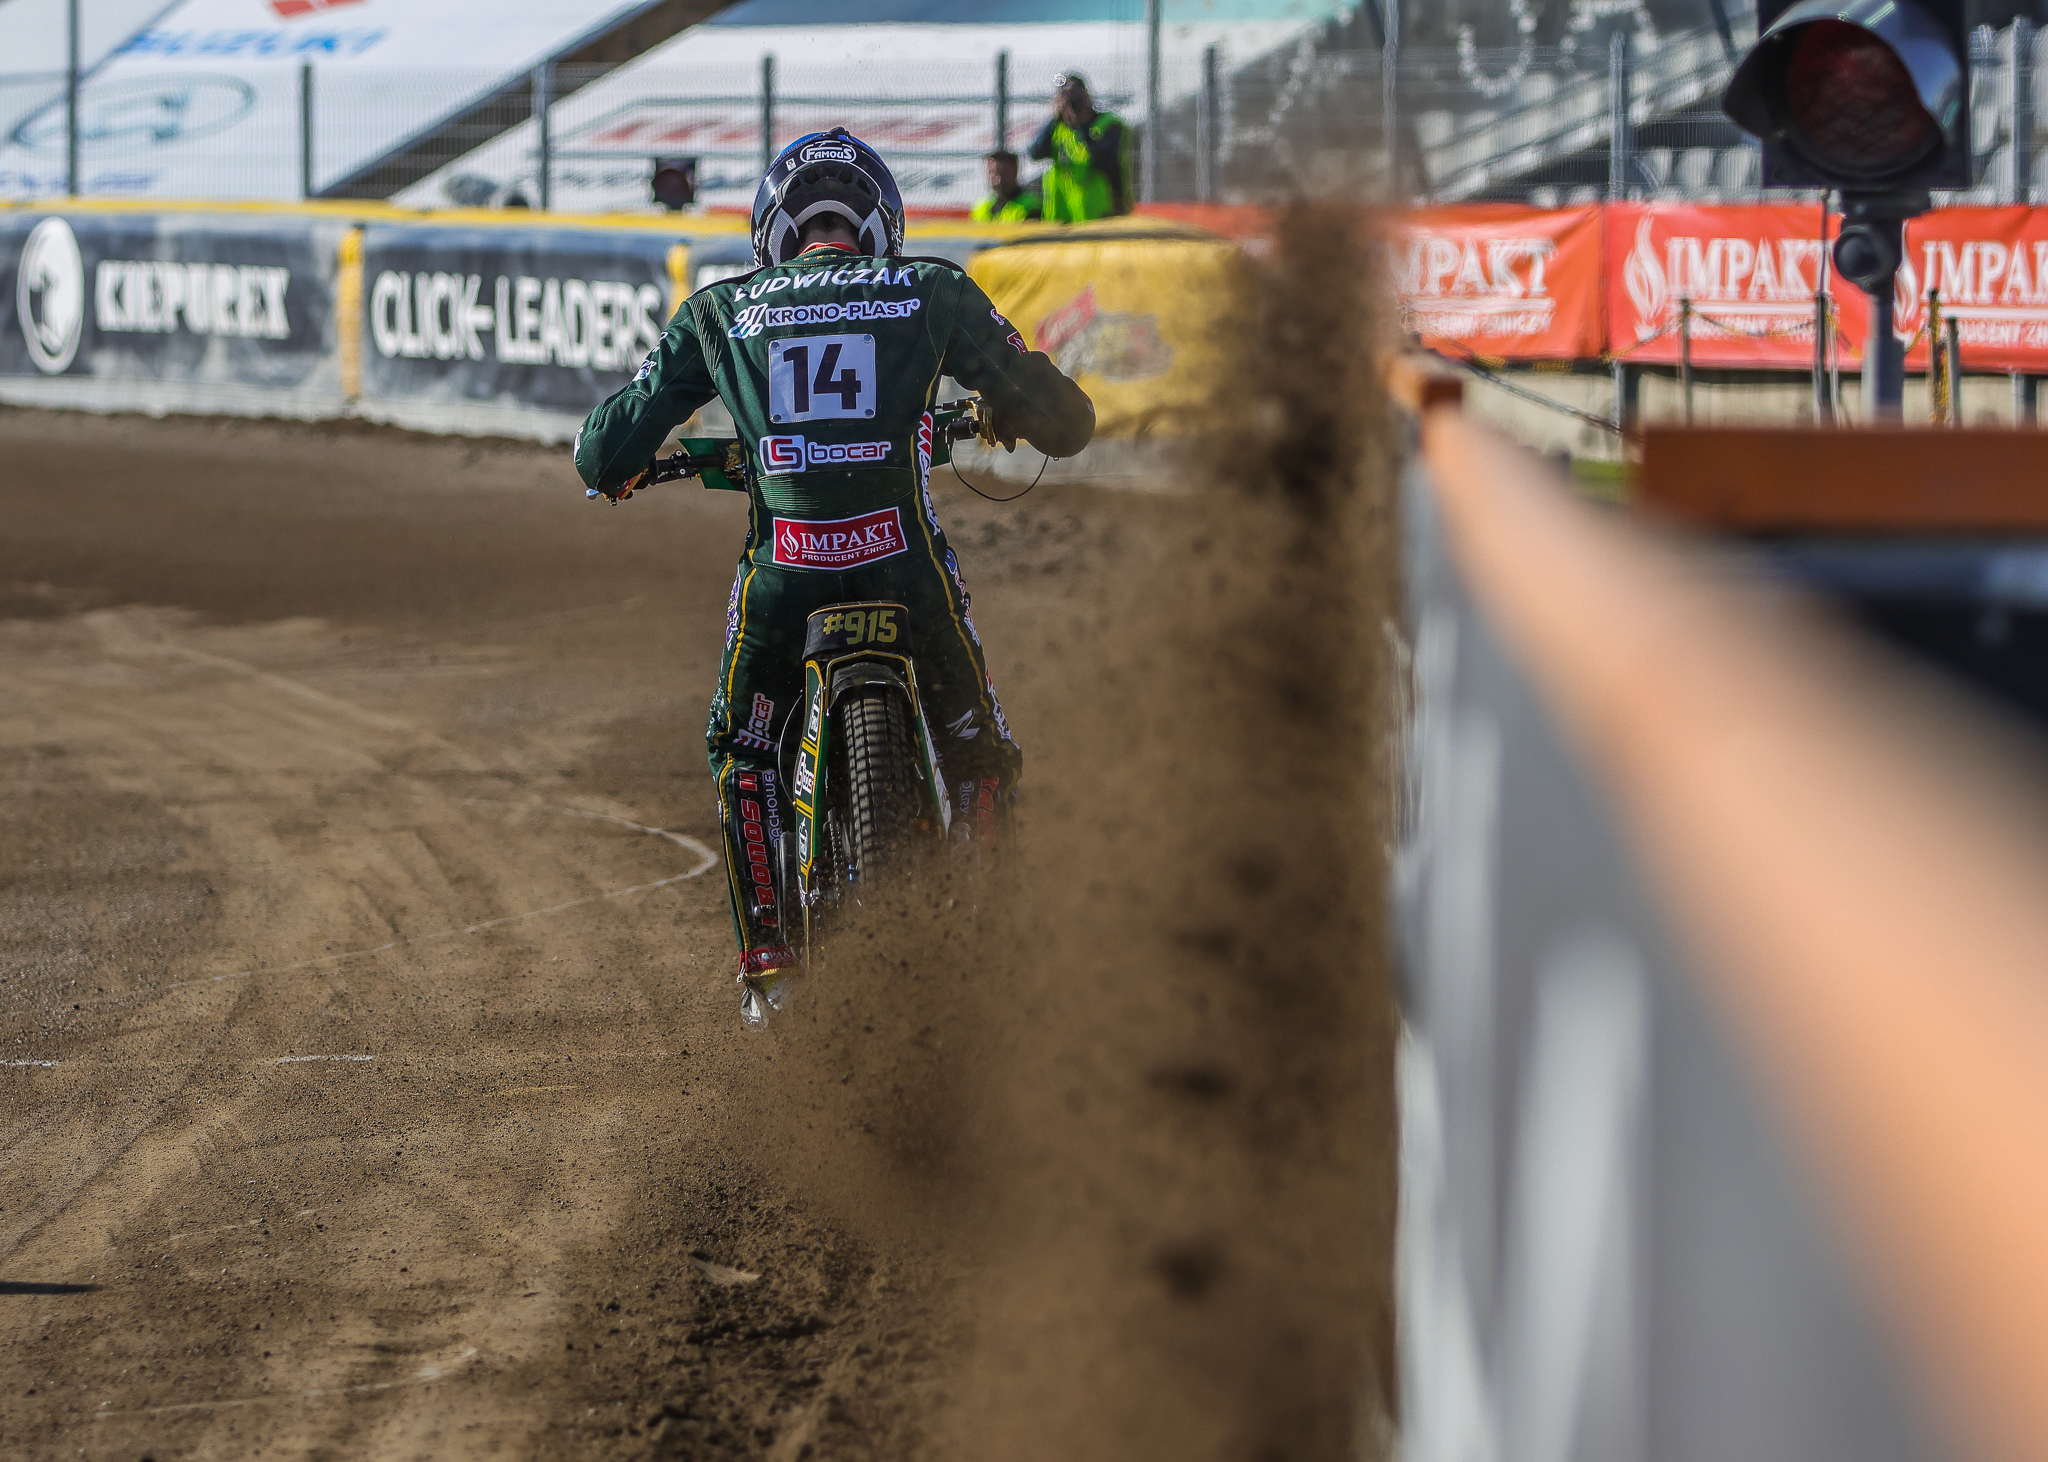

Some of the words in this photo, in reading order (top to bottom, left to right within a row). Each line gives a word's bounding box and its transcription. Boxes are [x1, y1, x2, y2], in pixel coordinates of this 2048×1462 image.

[1388, 237, 1557, 298] MPAKT
[782, 343, 862, 414] 14
[808, 442, 891, 462] bocar
[800, 521, 894, 551] IMPAKT
[801, 551, 861, 562] PRODUCENT
[864, 540, 897, 555] ZNICZY
[823, 610, 897, 645] #915
